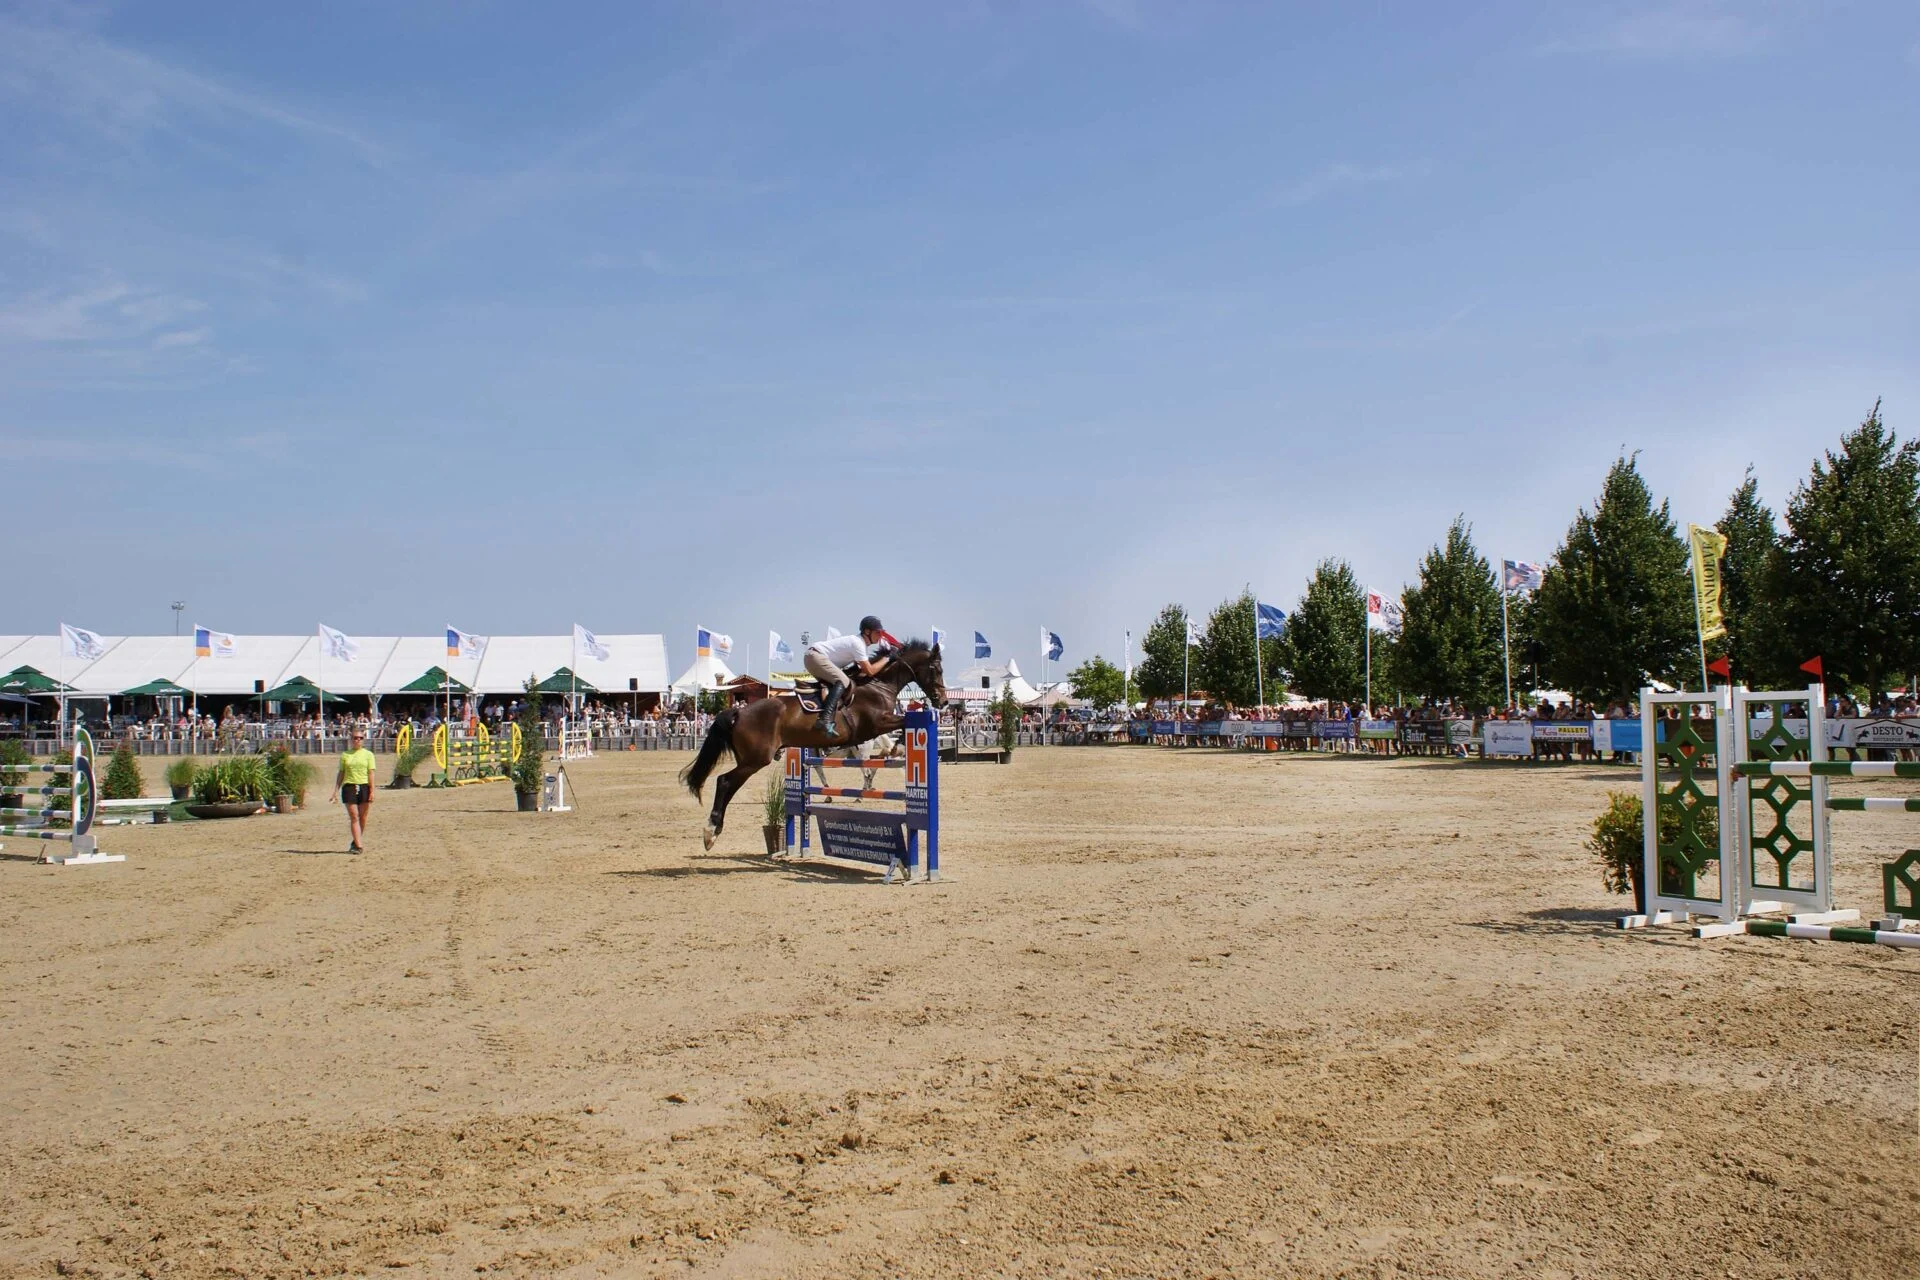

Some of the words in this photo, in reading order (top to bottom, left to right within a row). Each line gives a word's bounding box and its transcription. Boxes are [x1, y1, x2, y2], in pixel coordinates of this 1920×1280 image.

[1872, 726, 1903, 735] DESTO
[906, 787, 928, 799] HARTEN
[830, 845, 895, 862] WWW.HARTENVERHUUR.N
